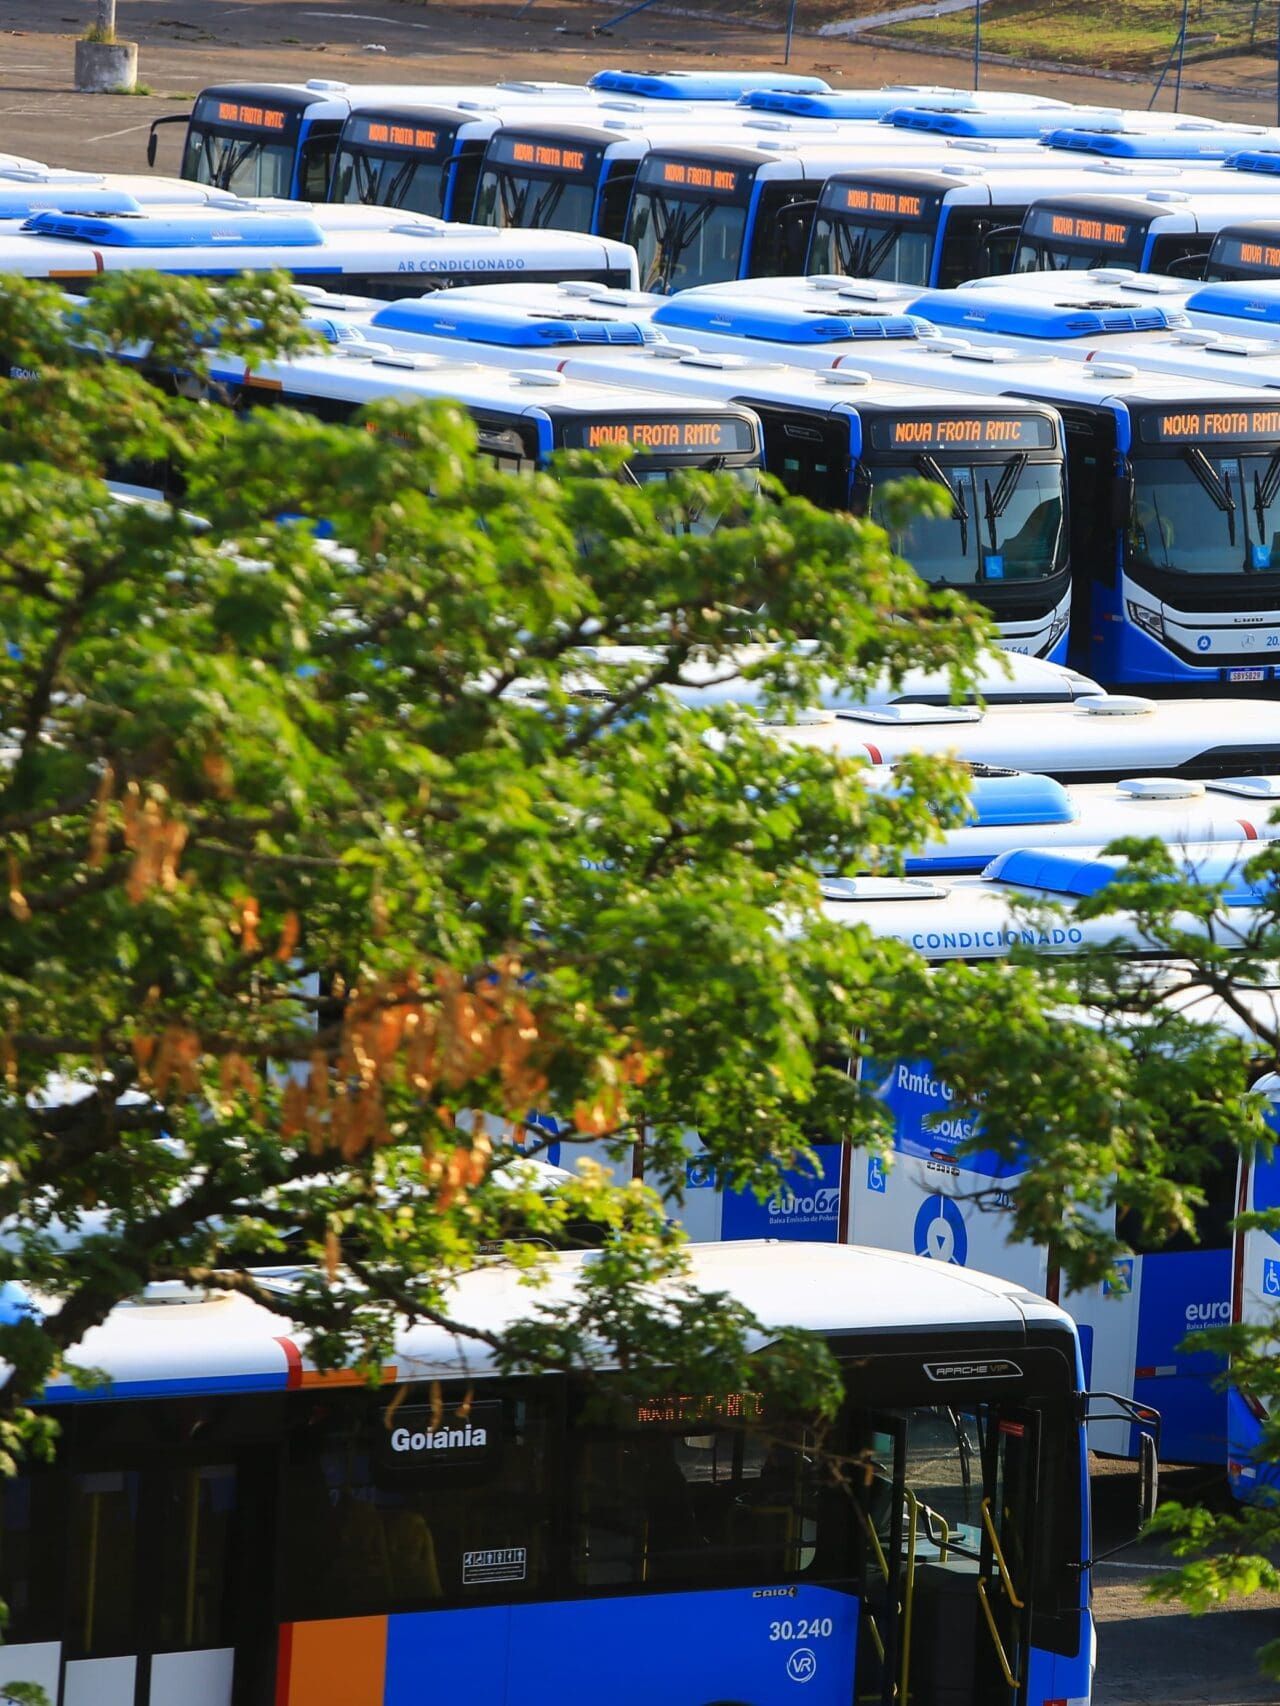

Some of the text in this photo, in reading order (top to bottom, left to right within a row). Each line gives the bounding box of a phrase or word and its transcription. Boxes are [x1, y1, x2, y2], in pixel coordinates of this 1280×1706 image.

[847, 189, 920, 216] NOVA FROTA RMTC
[1052, 216, 1126, 243] NOVA FROTA RMTC
[1241, 243, 1262, 263] NOVA
[398, 259, 525, 271] AR CONDICIONADO
[589, 423, 721, 447] NOVA FROTA RMTC
[895, 420, 1021, 442] NOVA FROTA RMTC
[1163, 415, 1199, 435] NOVA
[1204, 413, 1248, 434] FROTA
[898, 1065, 938, 1097] Rmtc
[936, 1366, 988, 1376] APACHE
[752, 1588, 788, 1598] CAIO
[769, 1618, 833, 1641] 30.240
